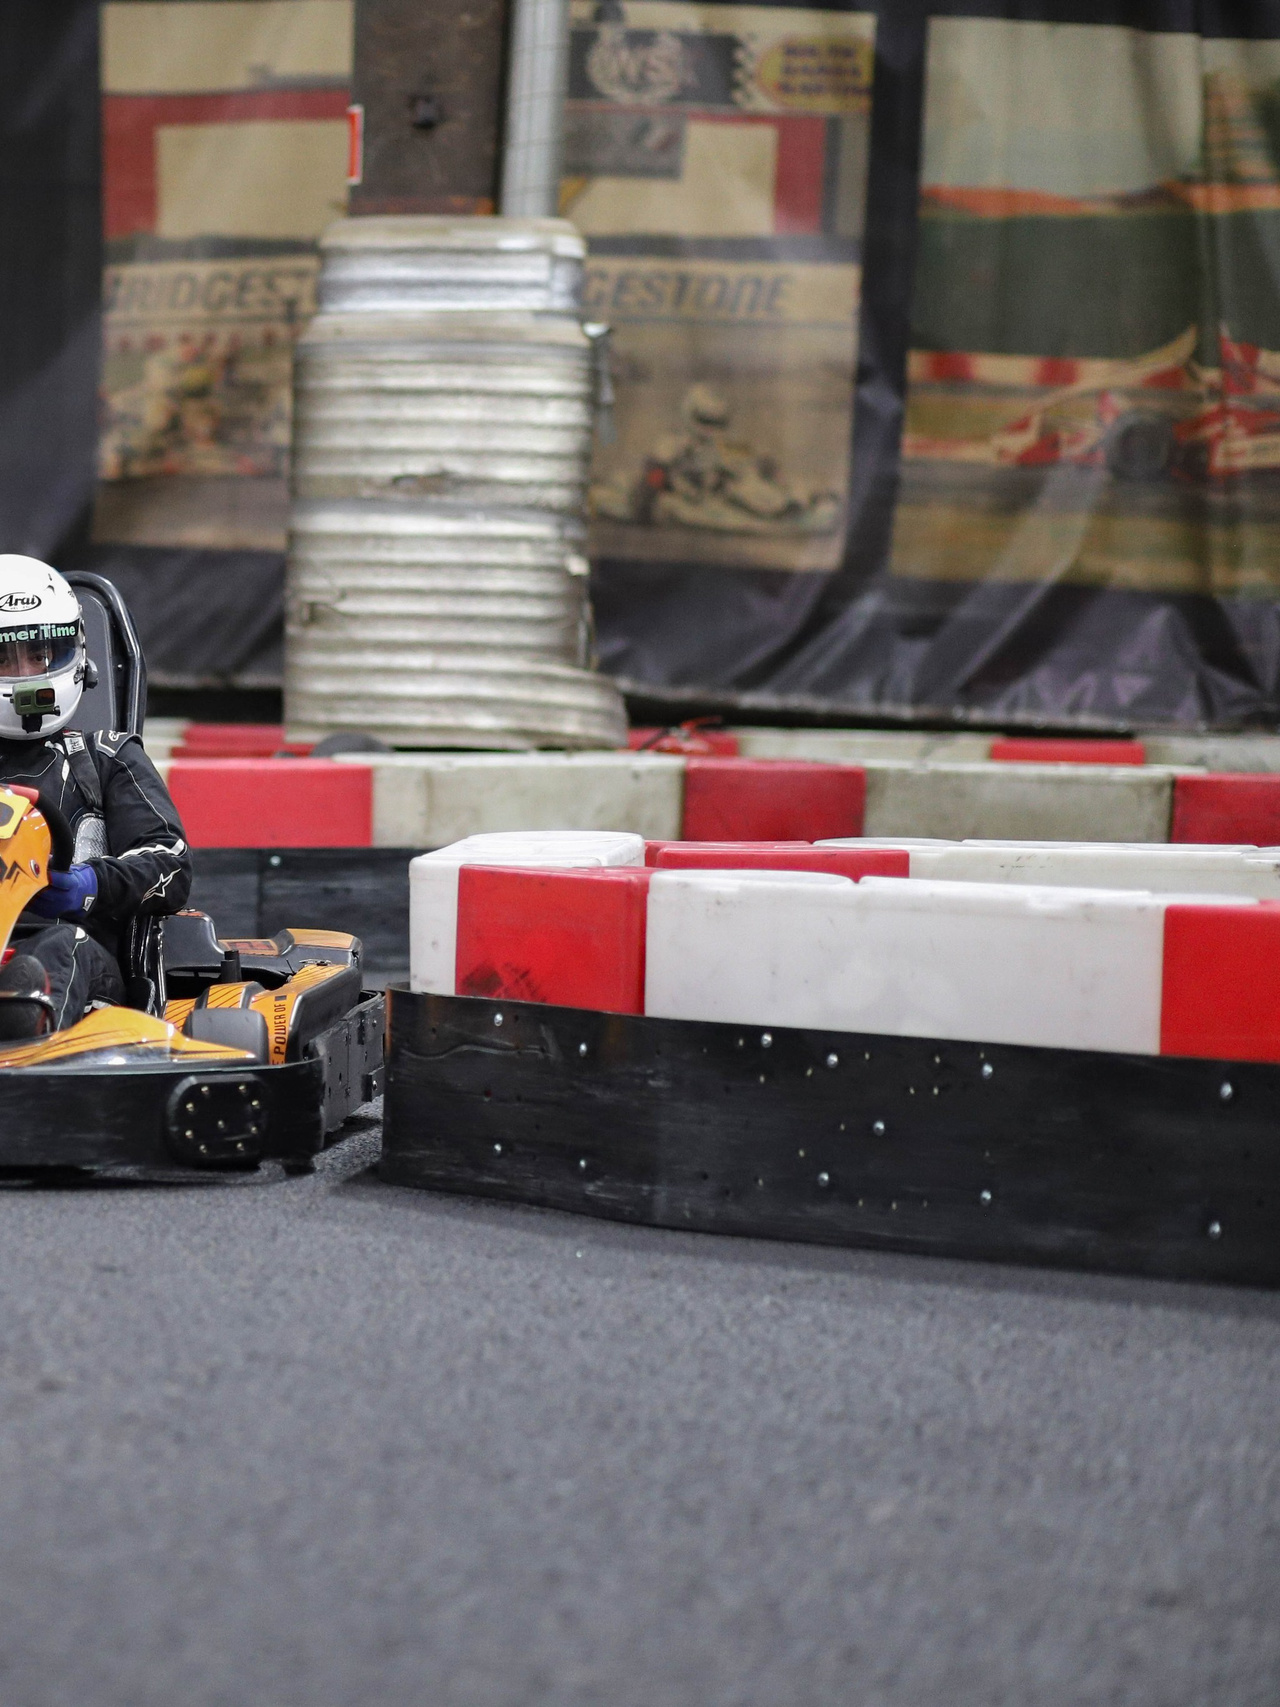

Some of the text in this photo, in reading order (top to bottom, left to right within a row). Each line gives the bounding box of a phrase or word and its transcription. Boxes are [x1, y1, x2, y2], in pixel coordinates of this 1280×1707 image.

[0, 594, 36, 608] Arai
[40, 624, 76, 638] Time
[274, 1003, 286, 1013] OF
[273, 1014, 287, 1056] POWER
